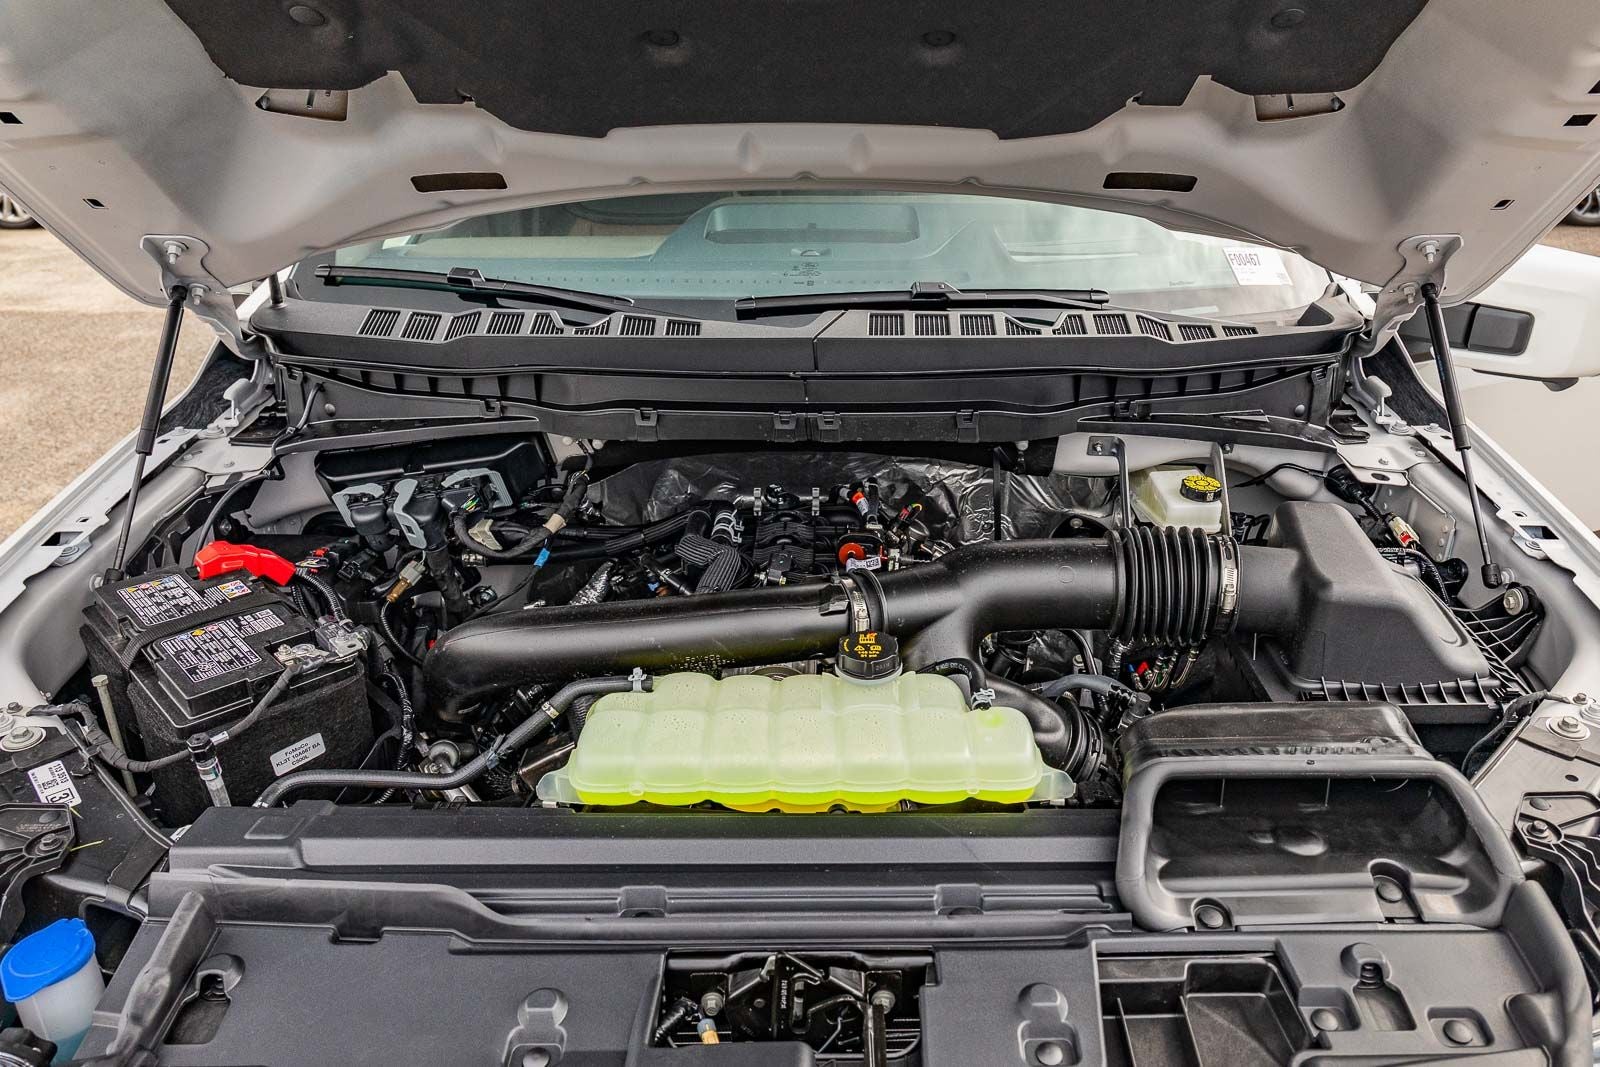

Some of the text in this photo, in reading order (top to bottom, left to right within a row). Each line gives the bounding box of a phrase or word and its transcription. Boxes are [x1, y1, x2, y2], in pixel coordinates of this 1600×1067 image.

[1228, 253, 1261, 266] F00467
[285, 743, 308, 756] FoMoCo
[50, 792, 70, 803] 3
